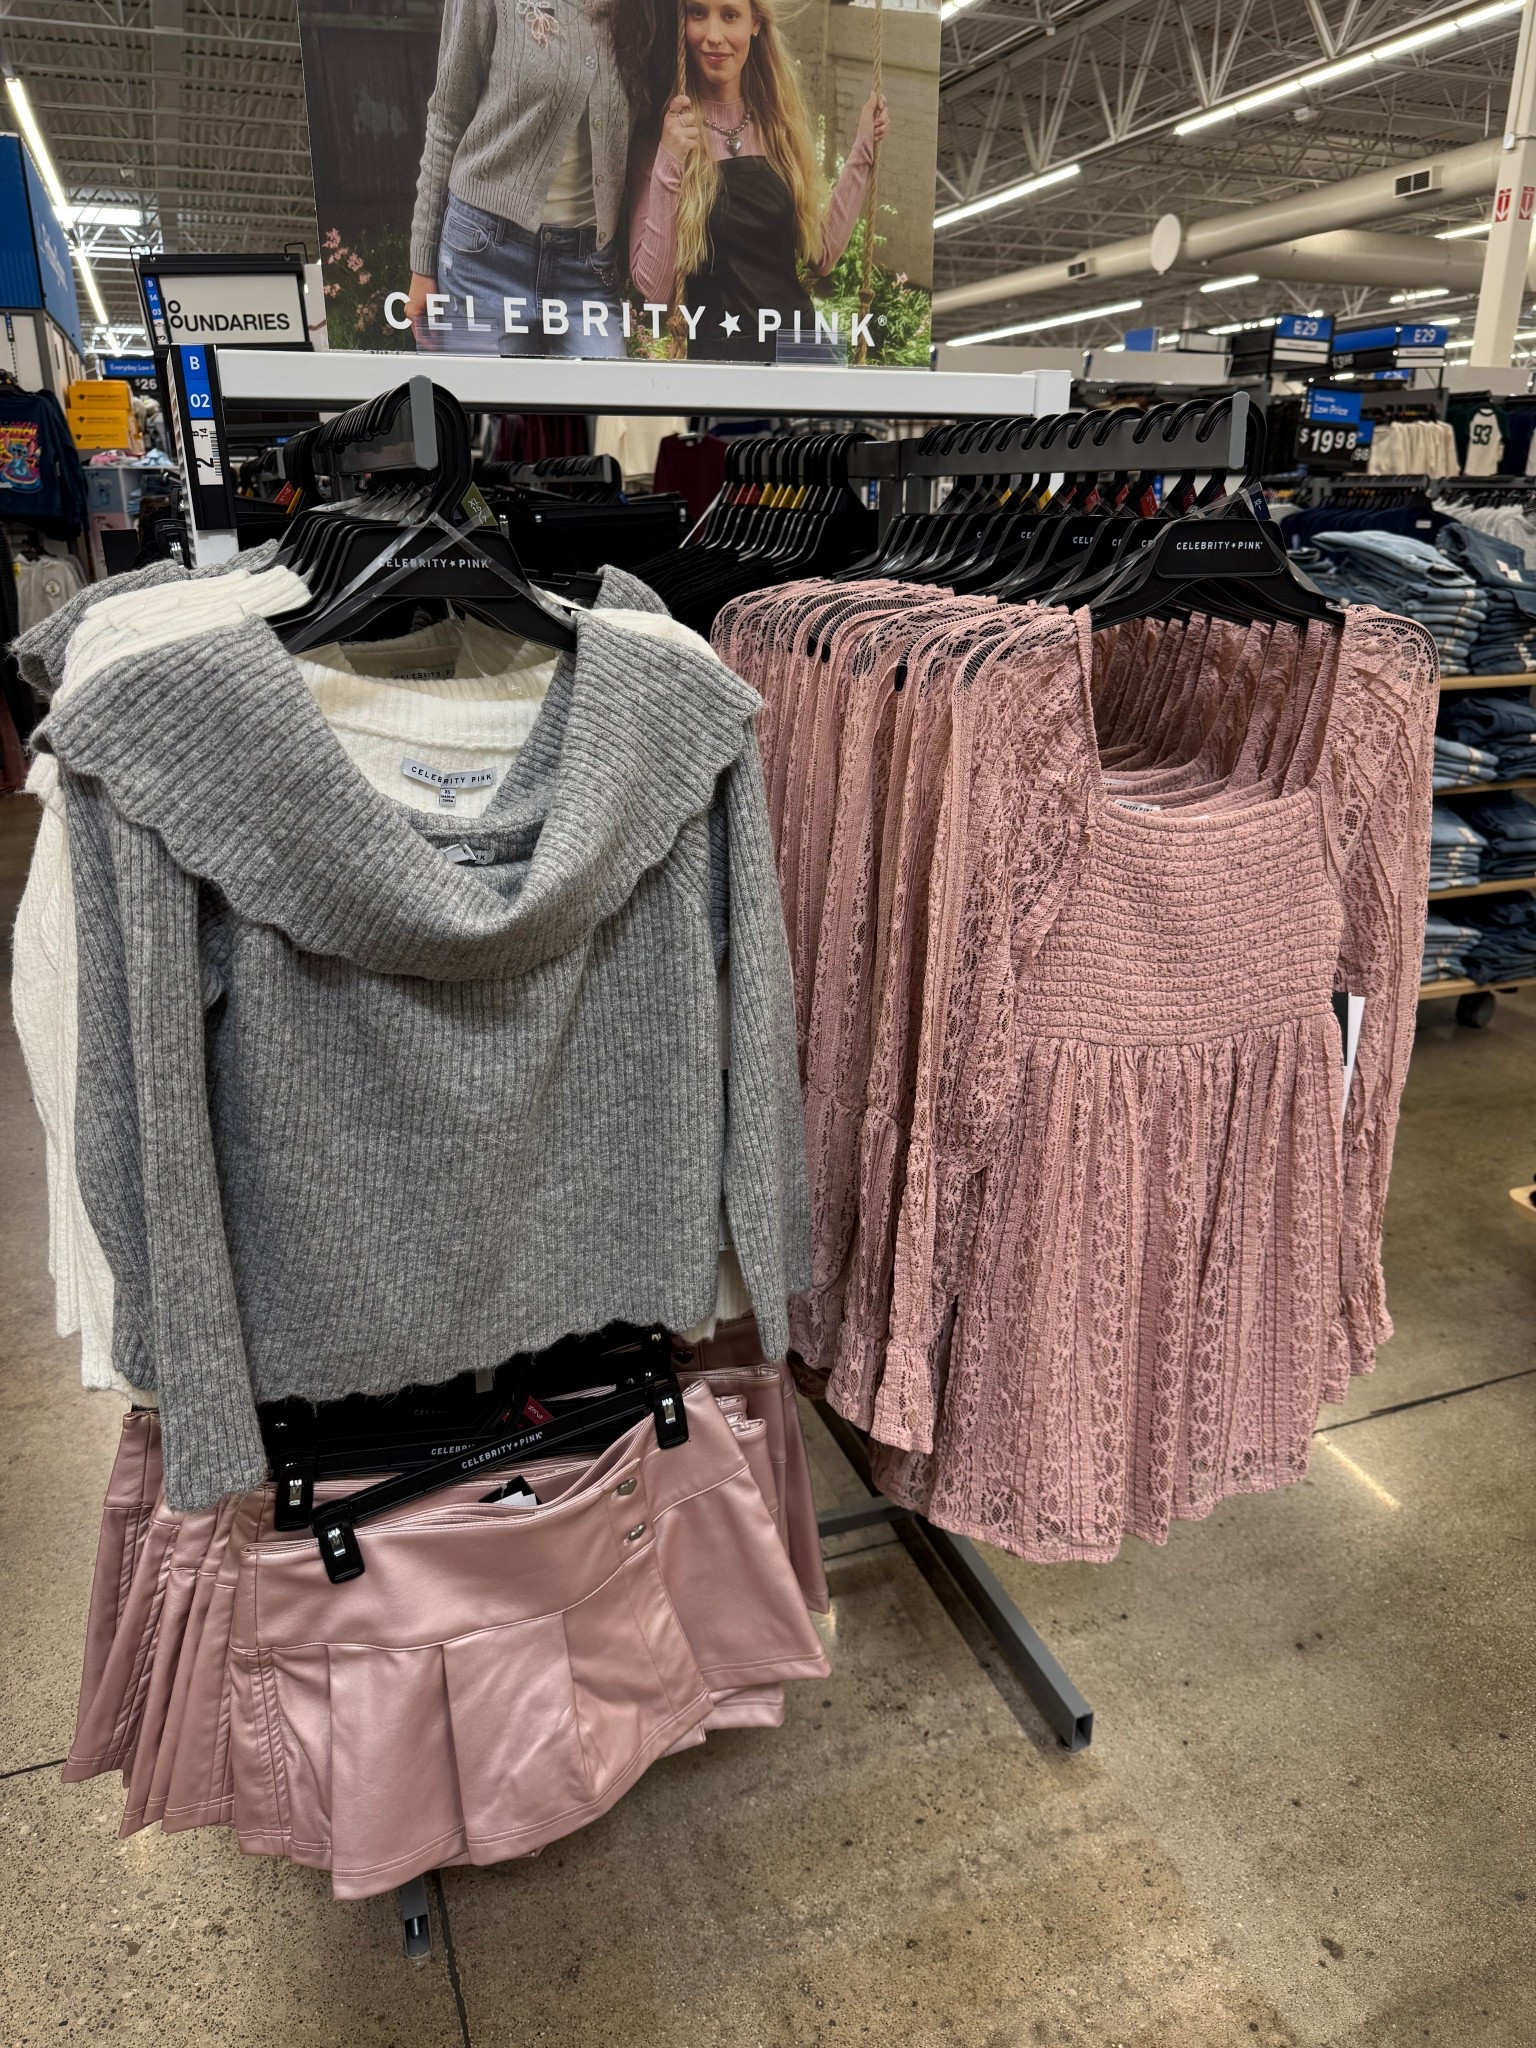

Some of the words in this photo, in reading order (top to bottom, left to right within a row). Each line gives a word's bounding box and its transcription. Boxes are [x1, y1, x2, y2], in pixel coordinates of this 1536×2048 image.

[170, 313, 290, 332] OUNDARIES
[384, 291, 706, 340] CELEBRITY
[1293, 320, 1319, 336] E29
[1414, 328, 1437, 343] E29
[189, 356, 200, 370] B
[190, 394, 210, 408] 02
[1472, 424, 1493, 446] 93
[1176, 541, 1230, 550] CELEBRITY
[411, 766, 466, 785] CELEBRITY
[471, 773, 493, 783] PINK
[461, 1442, 512, 1469] CELEBRITY
